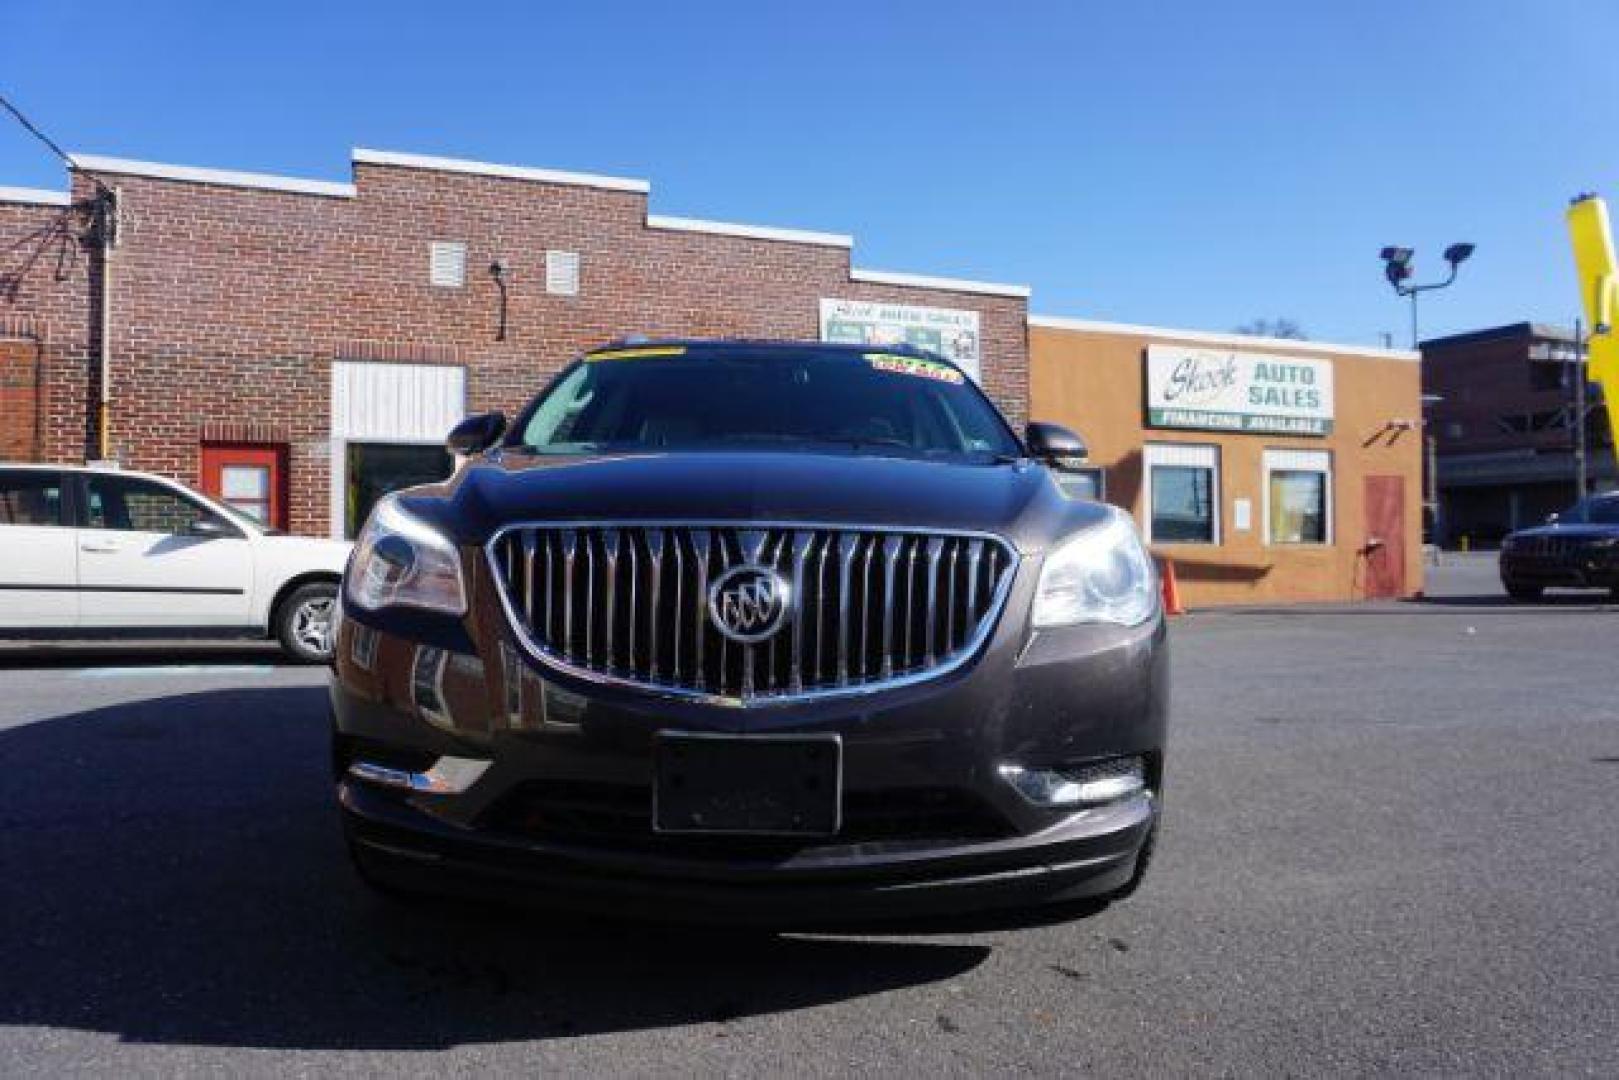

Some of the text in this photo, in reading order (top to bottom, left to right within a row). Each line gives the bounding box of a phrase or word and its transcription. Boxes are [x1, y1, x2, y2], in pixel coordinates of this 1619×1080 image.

[1164, 354, 1236, 401] Shook
[1254, 361, 1315, 385] AUTO
[1249, 386, 1319, 408] SALES
